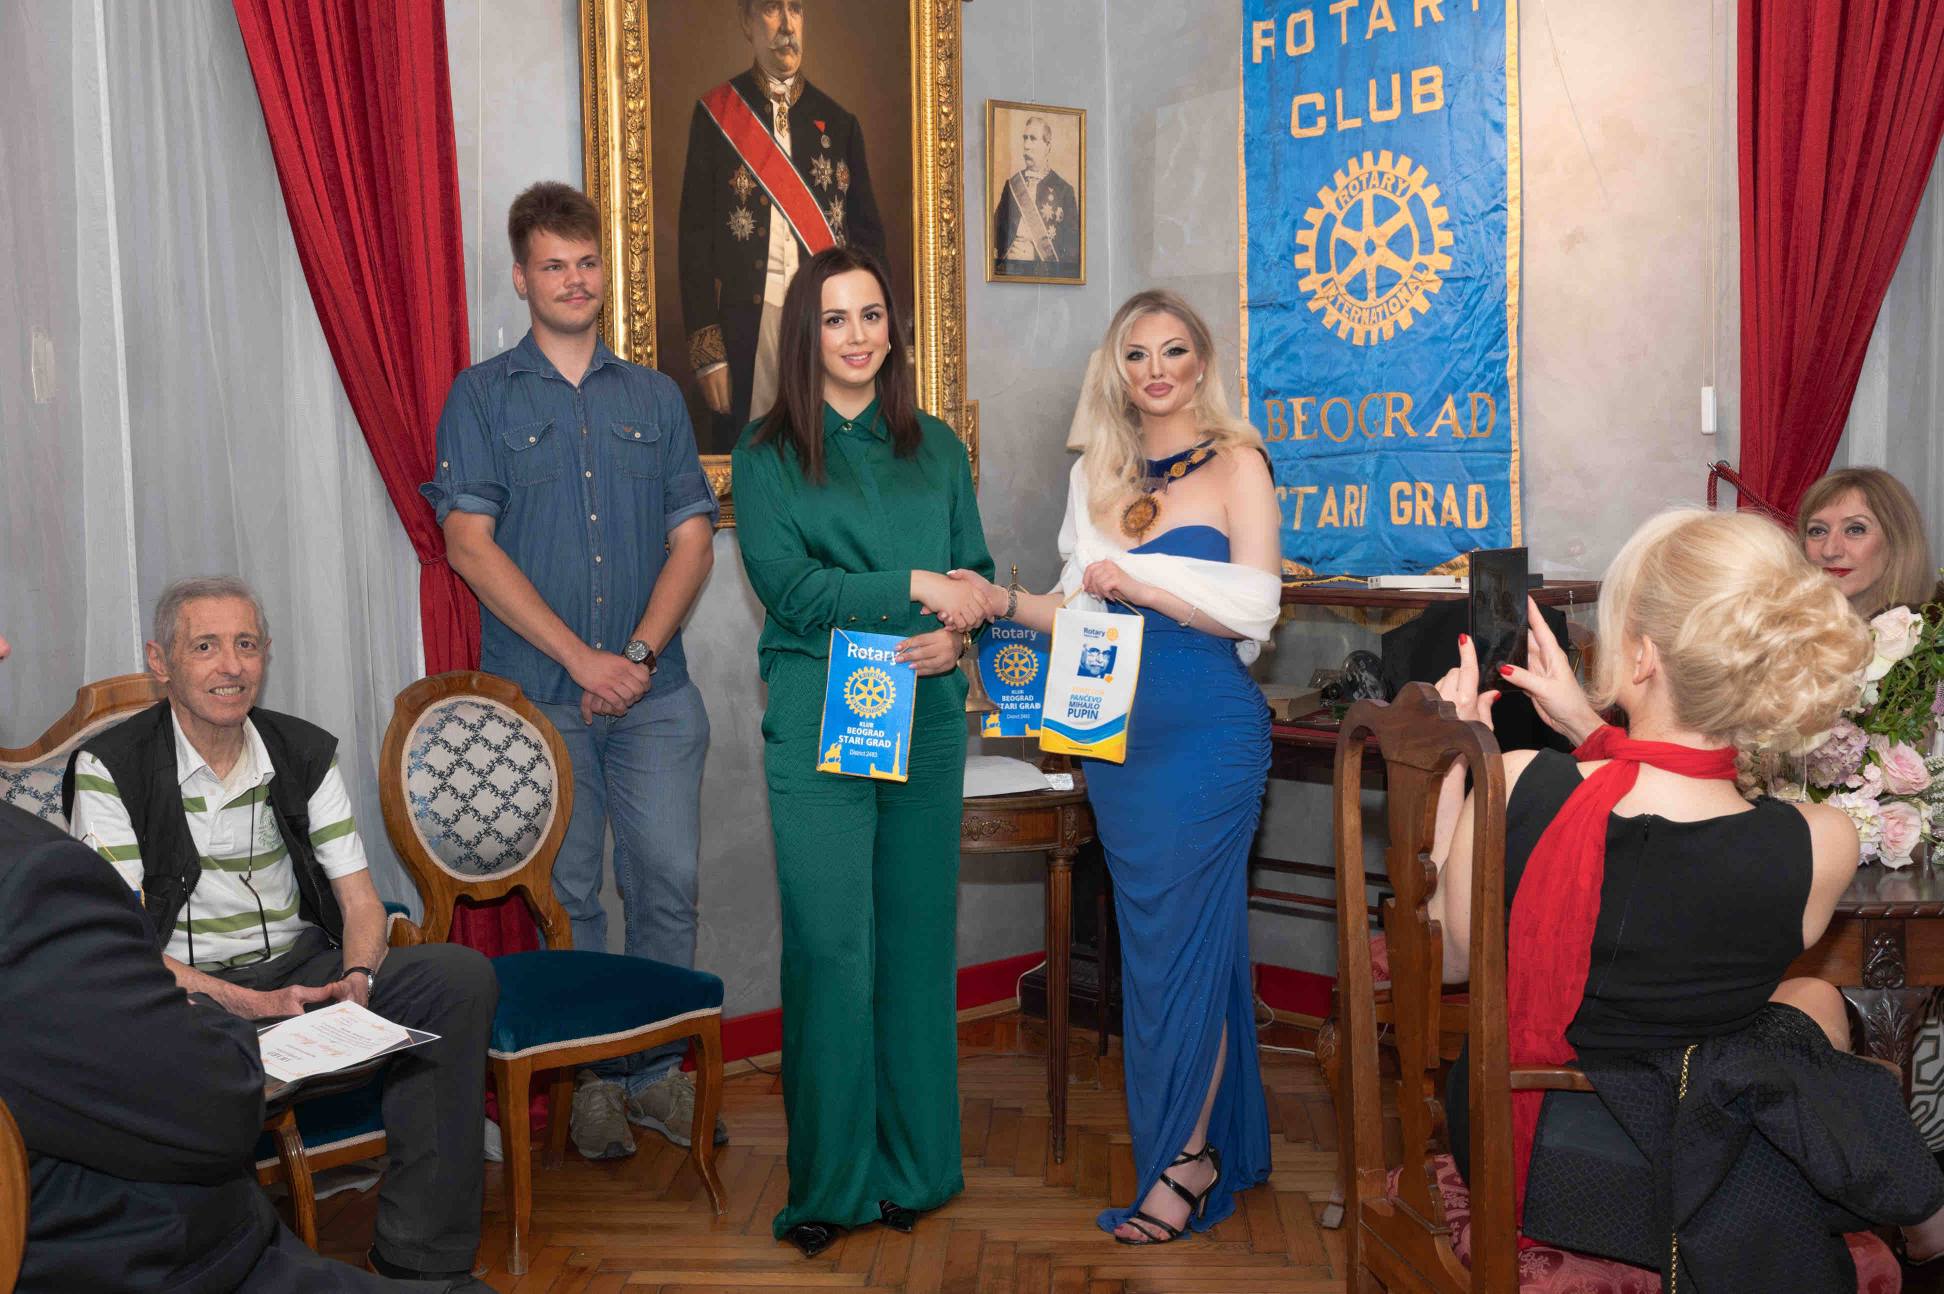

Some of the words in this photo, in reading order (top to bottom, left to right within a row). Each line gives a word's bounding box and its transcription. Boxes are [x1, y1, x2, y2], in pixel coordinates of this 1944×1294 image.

[1290, 65, 1445, 139] CLUB
[1335, 169, 1412, 212] ROTARY
[1263, 391, 1497, 443] BEOGRAD
[1389, 481, 1489, 530] GRAD
[991, 627, 1038, 641] Rotary
[1083, 627, 1105, 638] Rotary
[847, 642, 897, 666] Rotary
[1019, 702, 1041, 710] GRAD
[1069, 700, 1101, 711] MIHAJLO
[1067, 707, 1099, 720] PUPIN
[846, 726, 885, 738] BEOGRAD
[838, 734, 864, 746] STARI
[865, 737, 892, 748] GRAD
